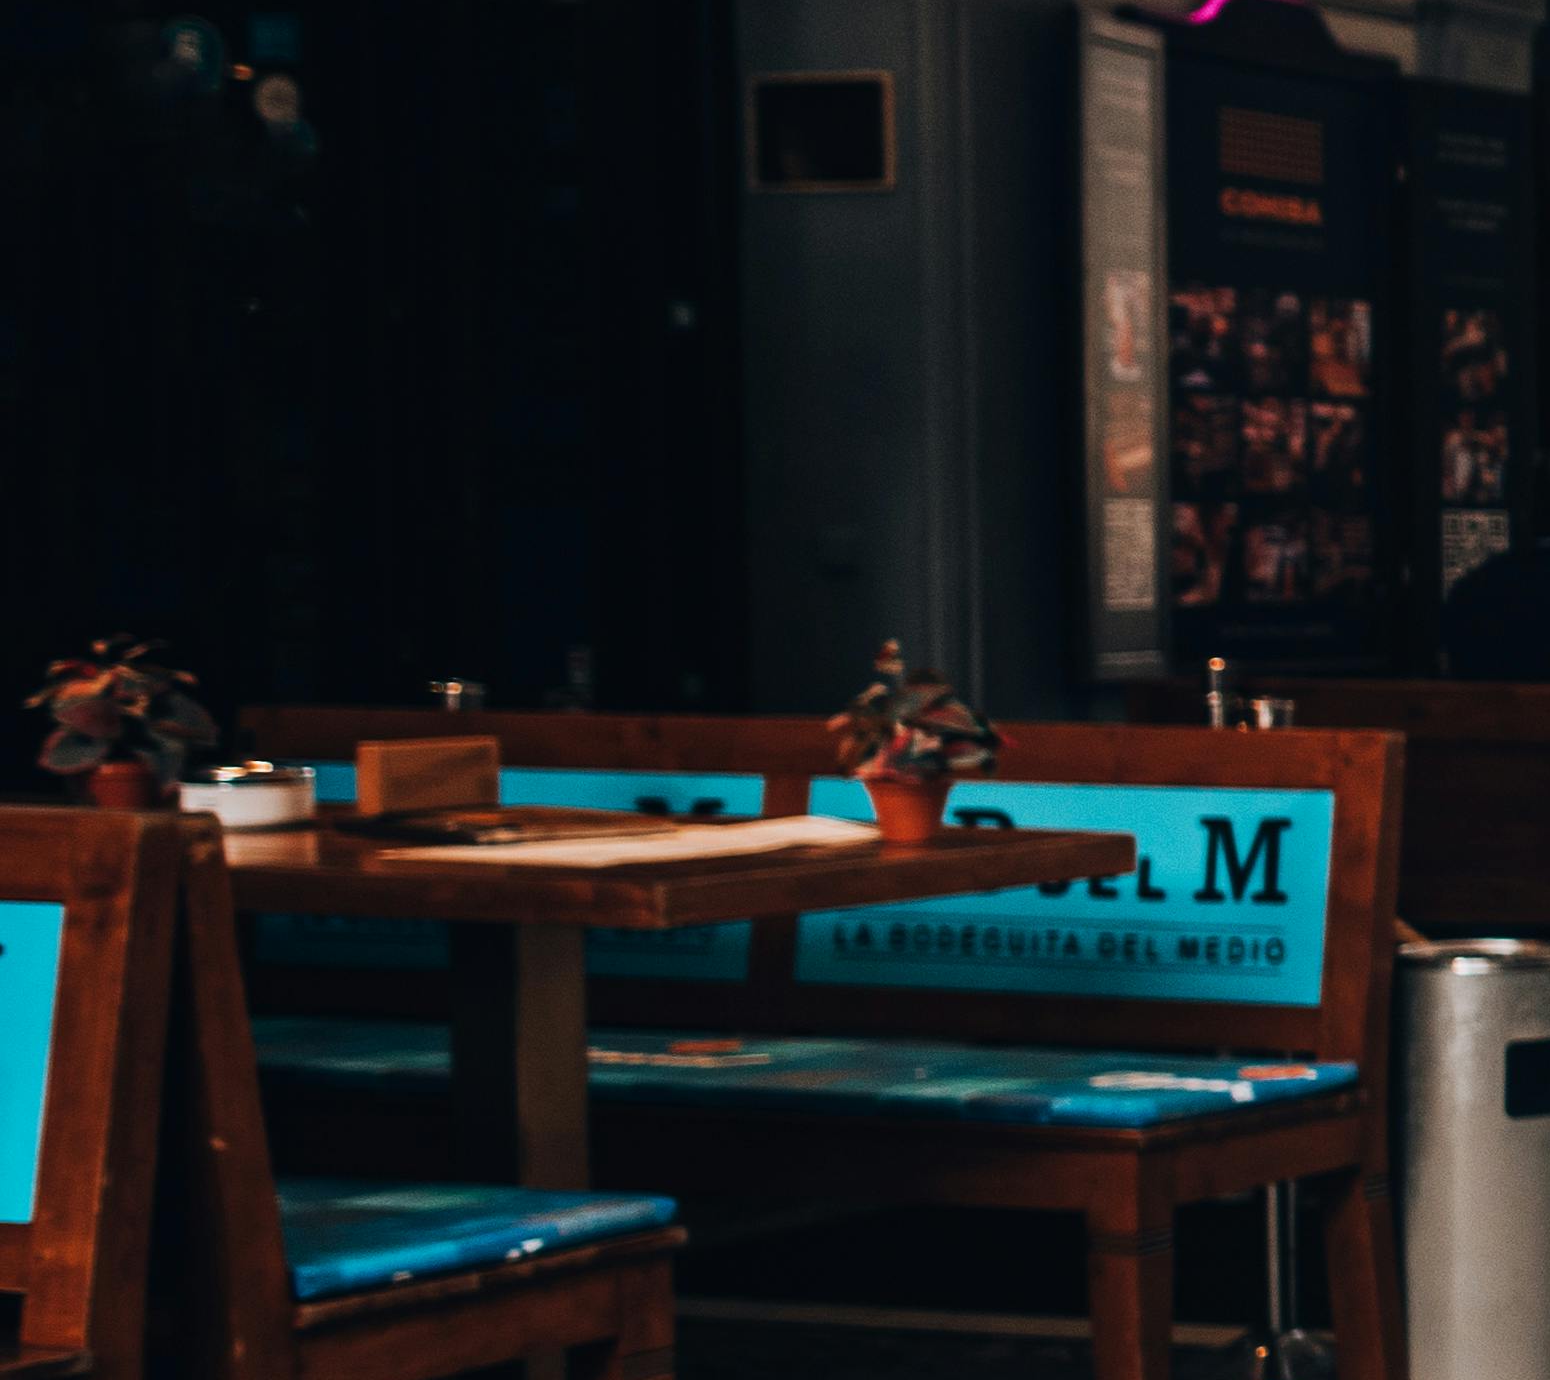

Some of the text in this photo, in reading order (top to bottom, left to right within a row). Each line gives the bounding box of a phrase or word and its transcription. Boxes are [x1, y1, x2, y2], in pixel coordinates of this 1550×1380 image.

[1193, 815, 1294, 904] M
[1097, 928, 1160, 963] DEL
[1176, 933, 1287, 969] MEDIO
